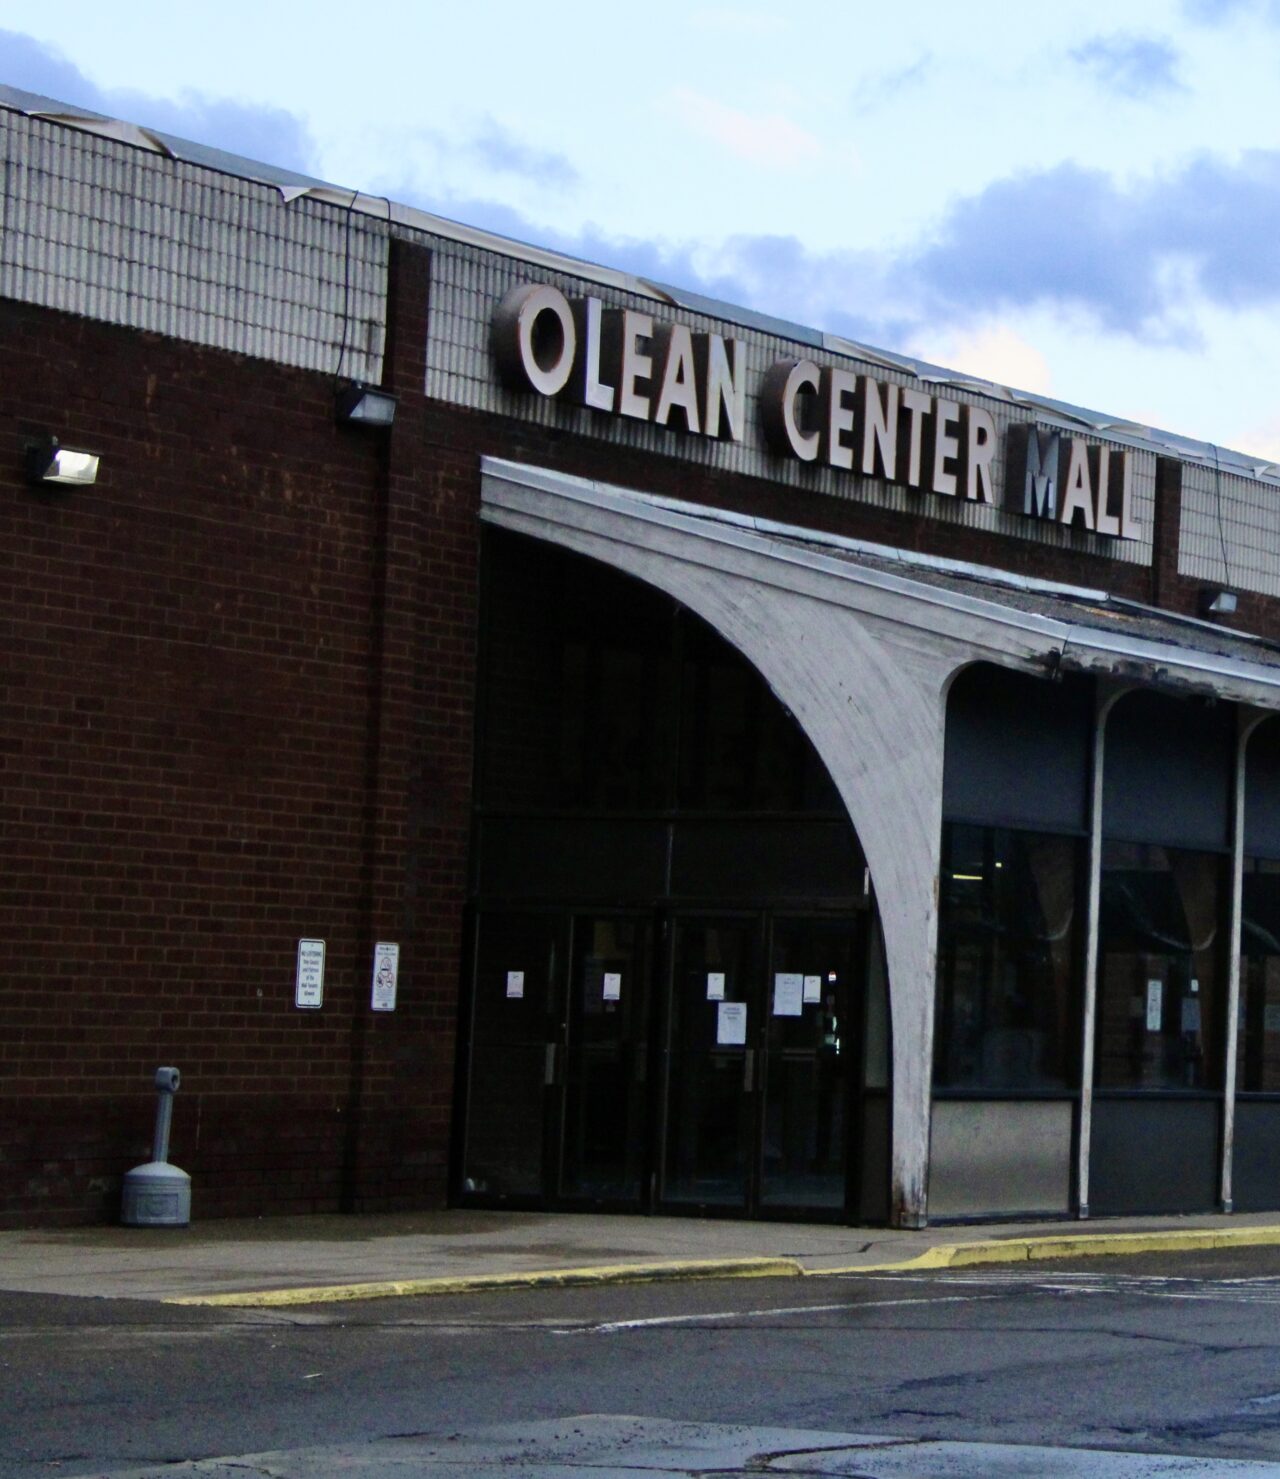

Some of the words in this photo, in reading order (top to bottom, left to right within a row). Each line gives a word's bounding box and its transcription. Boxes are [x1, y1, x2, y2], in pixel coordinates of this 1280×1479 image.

[517, 284, 746, 442] OLEAN
[781, 359, 997, 504] CENTER
[1024, 423, 1143, 541] MALL
